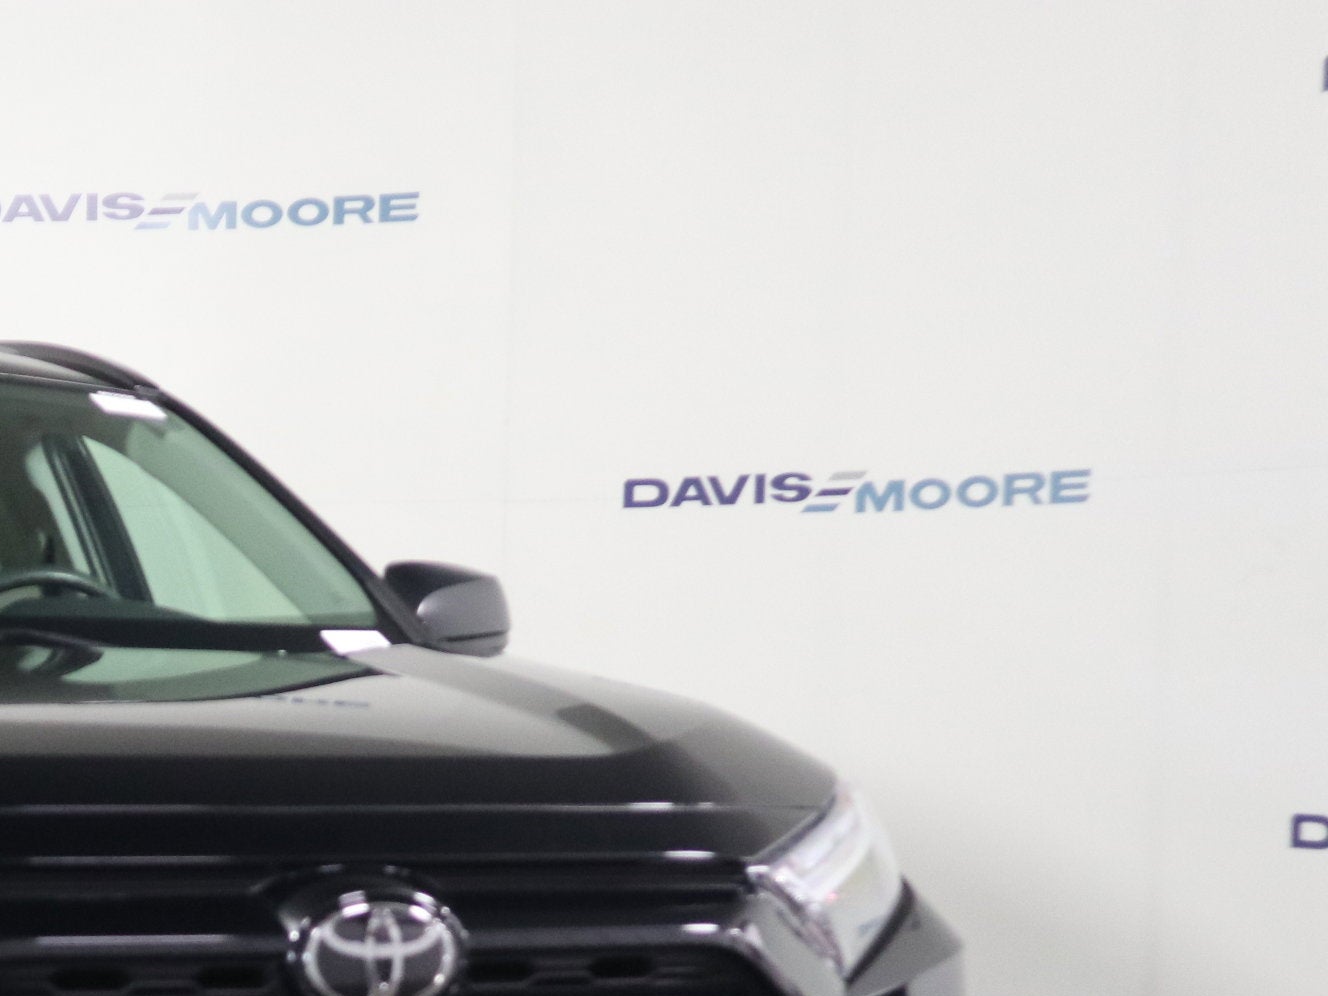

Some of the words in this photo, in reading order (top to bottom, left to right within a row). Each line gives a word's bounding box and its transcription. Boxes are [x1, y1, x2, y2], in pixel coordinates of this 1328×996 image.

[187, 191, 420, 231] MOORE
[622, 472, 813, 509] DAVIS
[854, 468, 1092, 513] MOORE
